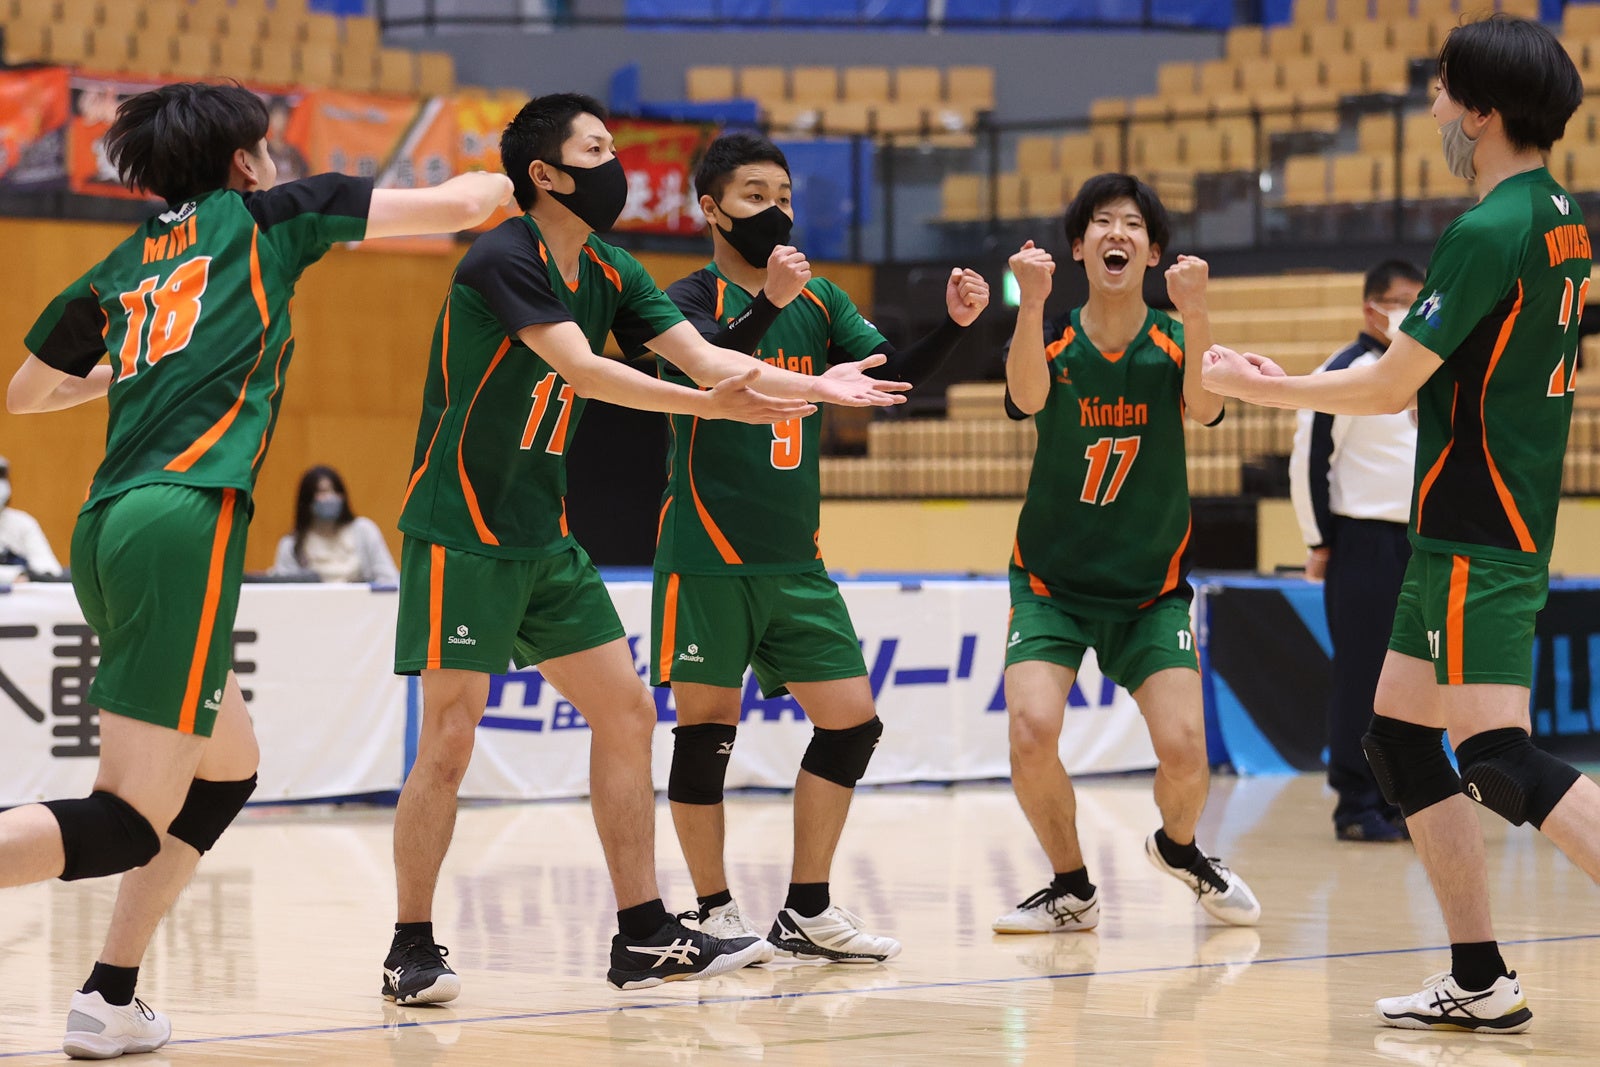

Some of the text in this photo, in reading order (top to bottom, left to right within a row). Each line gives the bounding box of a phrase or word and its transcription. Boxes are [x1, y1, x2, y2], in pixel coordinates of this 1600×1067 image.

[142, 214, 197, 265] MIKI
[116, 255, 213, 383] 18
[519, 371, 576, 456] 11
[1077, 396, 1148, 427] Kinden
[770, 415, 803, 470] 9
[1079, 435, 1141, 506] 17
[447, 635, 477, 646] Squadra
[678, 653, 705, 663] Squadra
